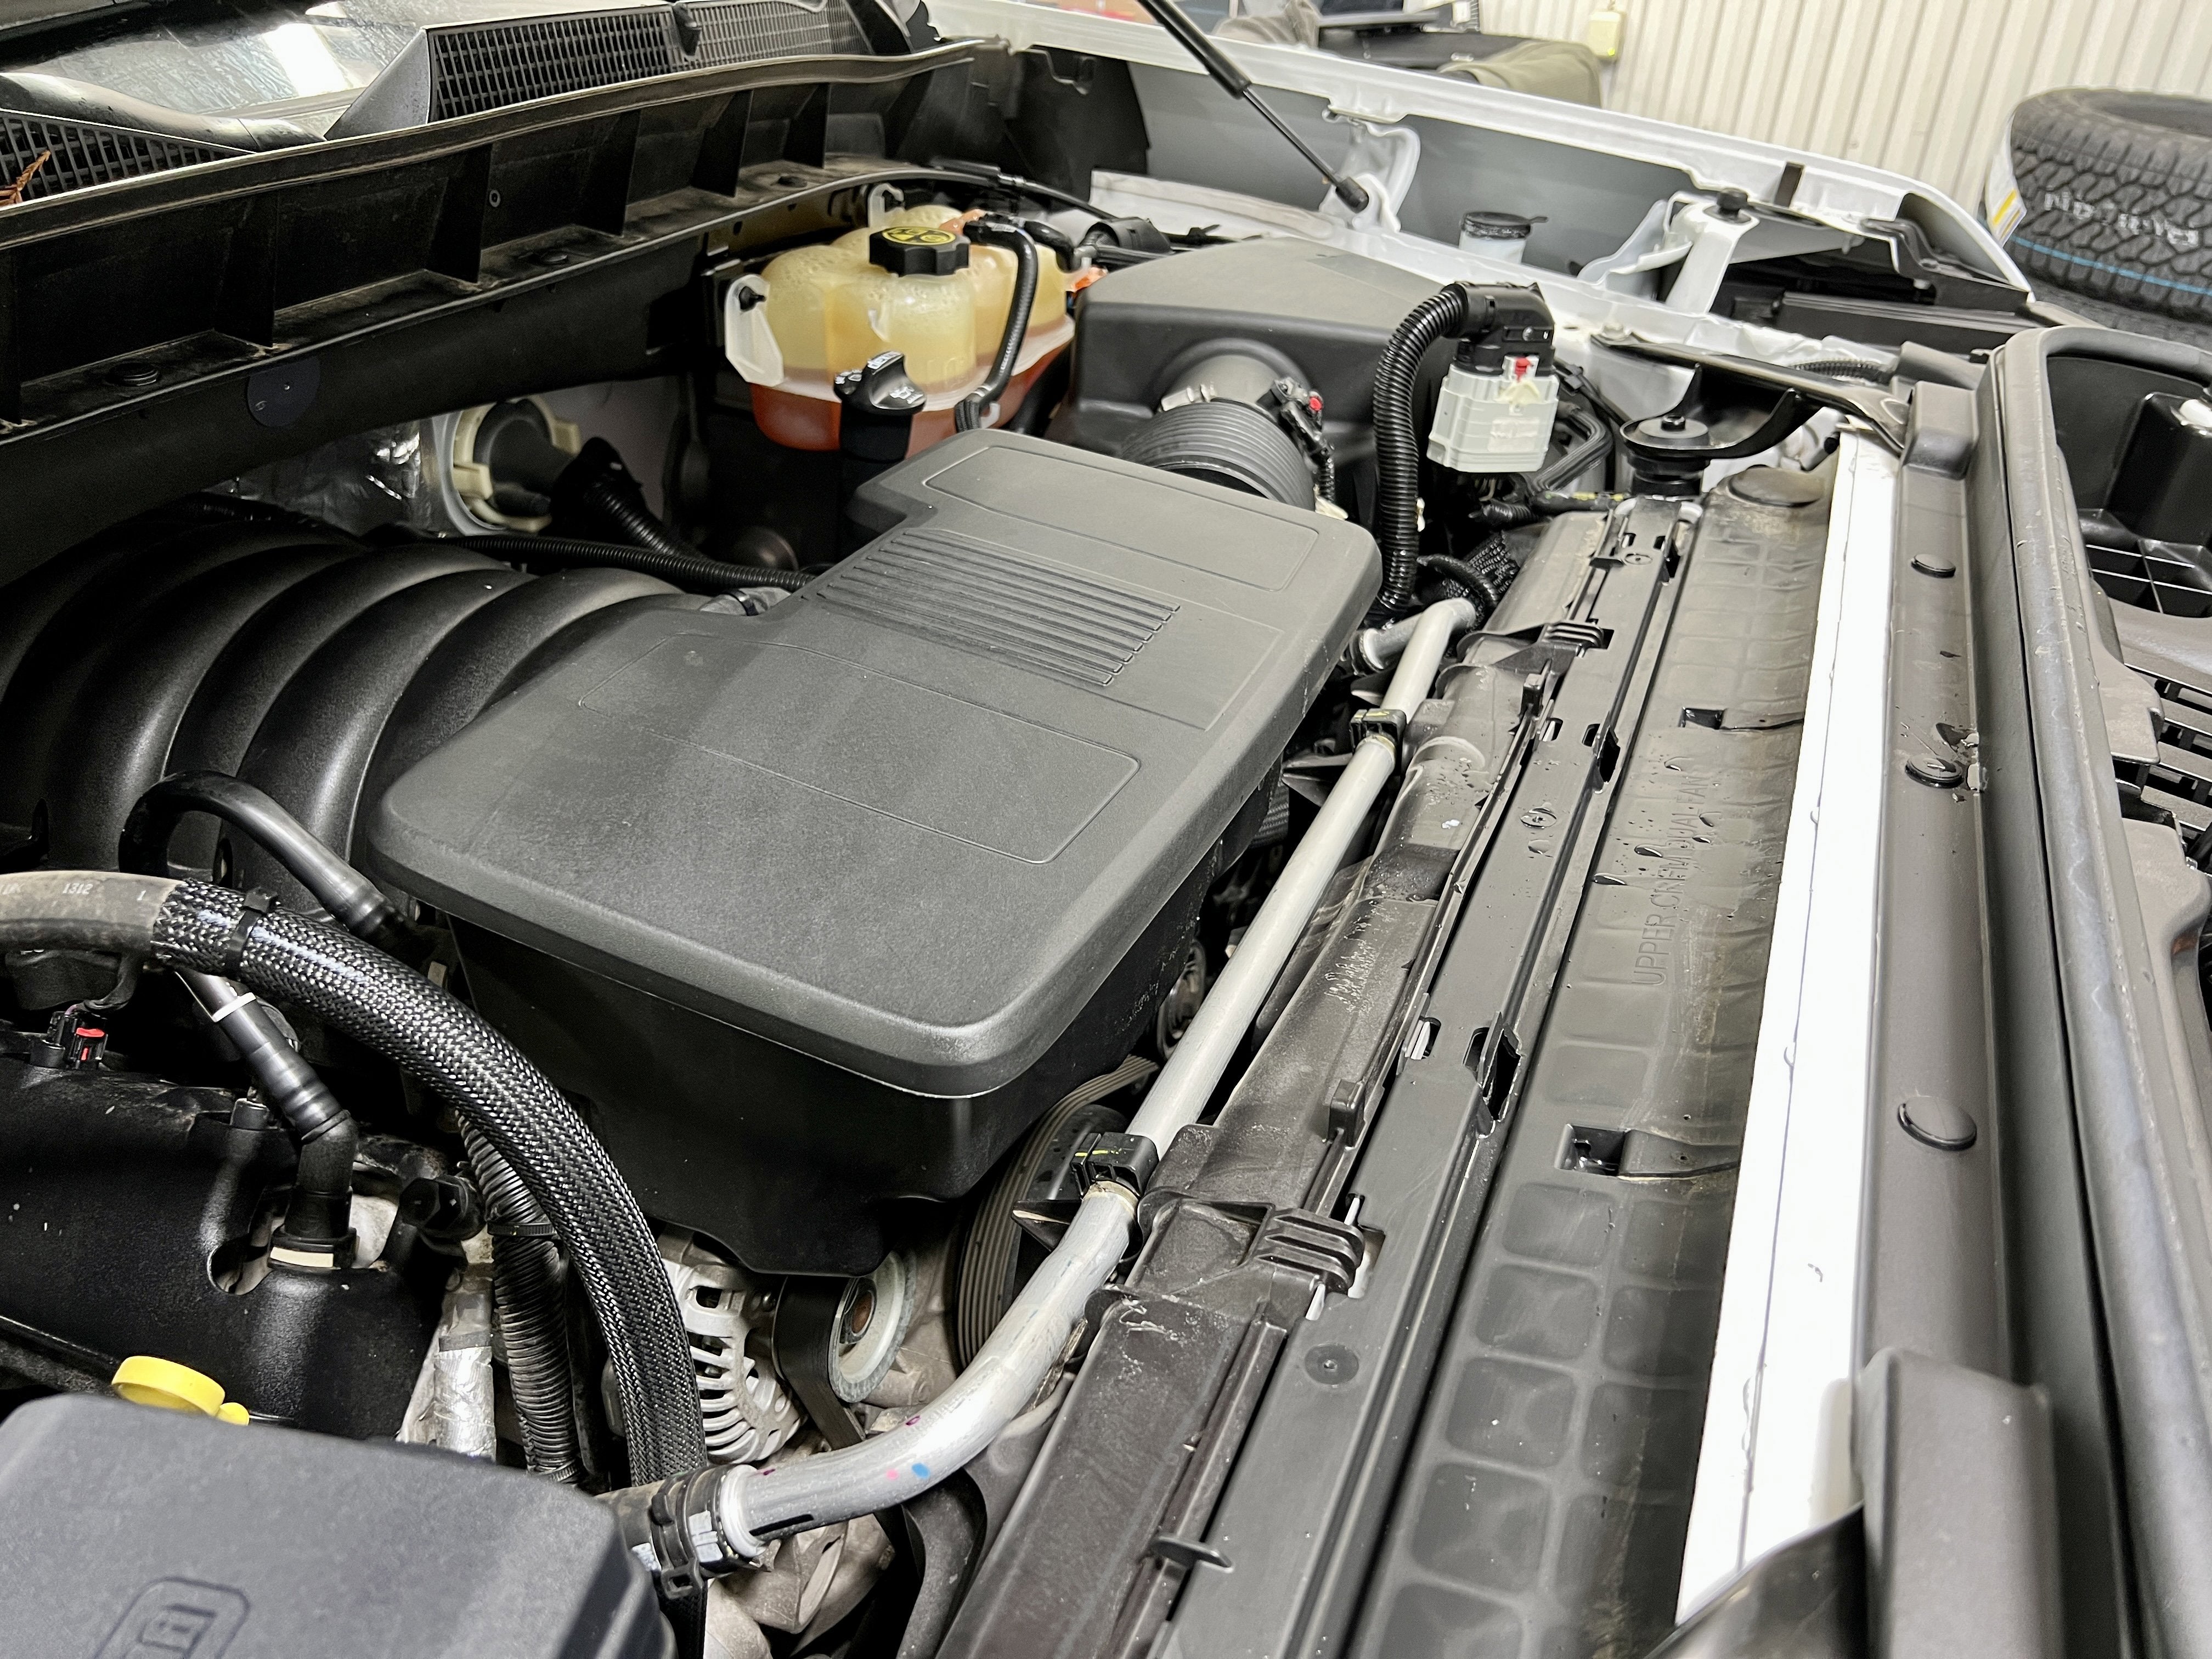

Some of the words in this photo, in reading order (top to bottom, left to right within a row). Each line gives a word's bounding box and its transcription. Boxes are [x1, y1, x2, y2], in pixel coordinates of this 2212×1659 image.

[62, 883, 93, 895] 1312
[136, 890, 146, 901] 1
[1632, 913, 1675, 986] UPPER
[1677, 776, 1709, 804] FAN
